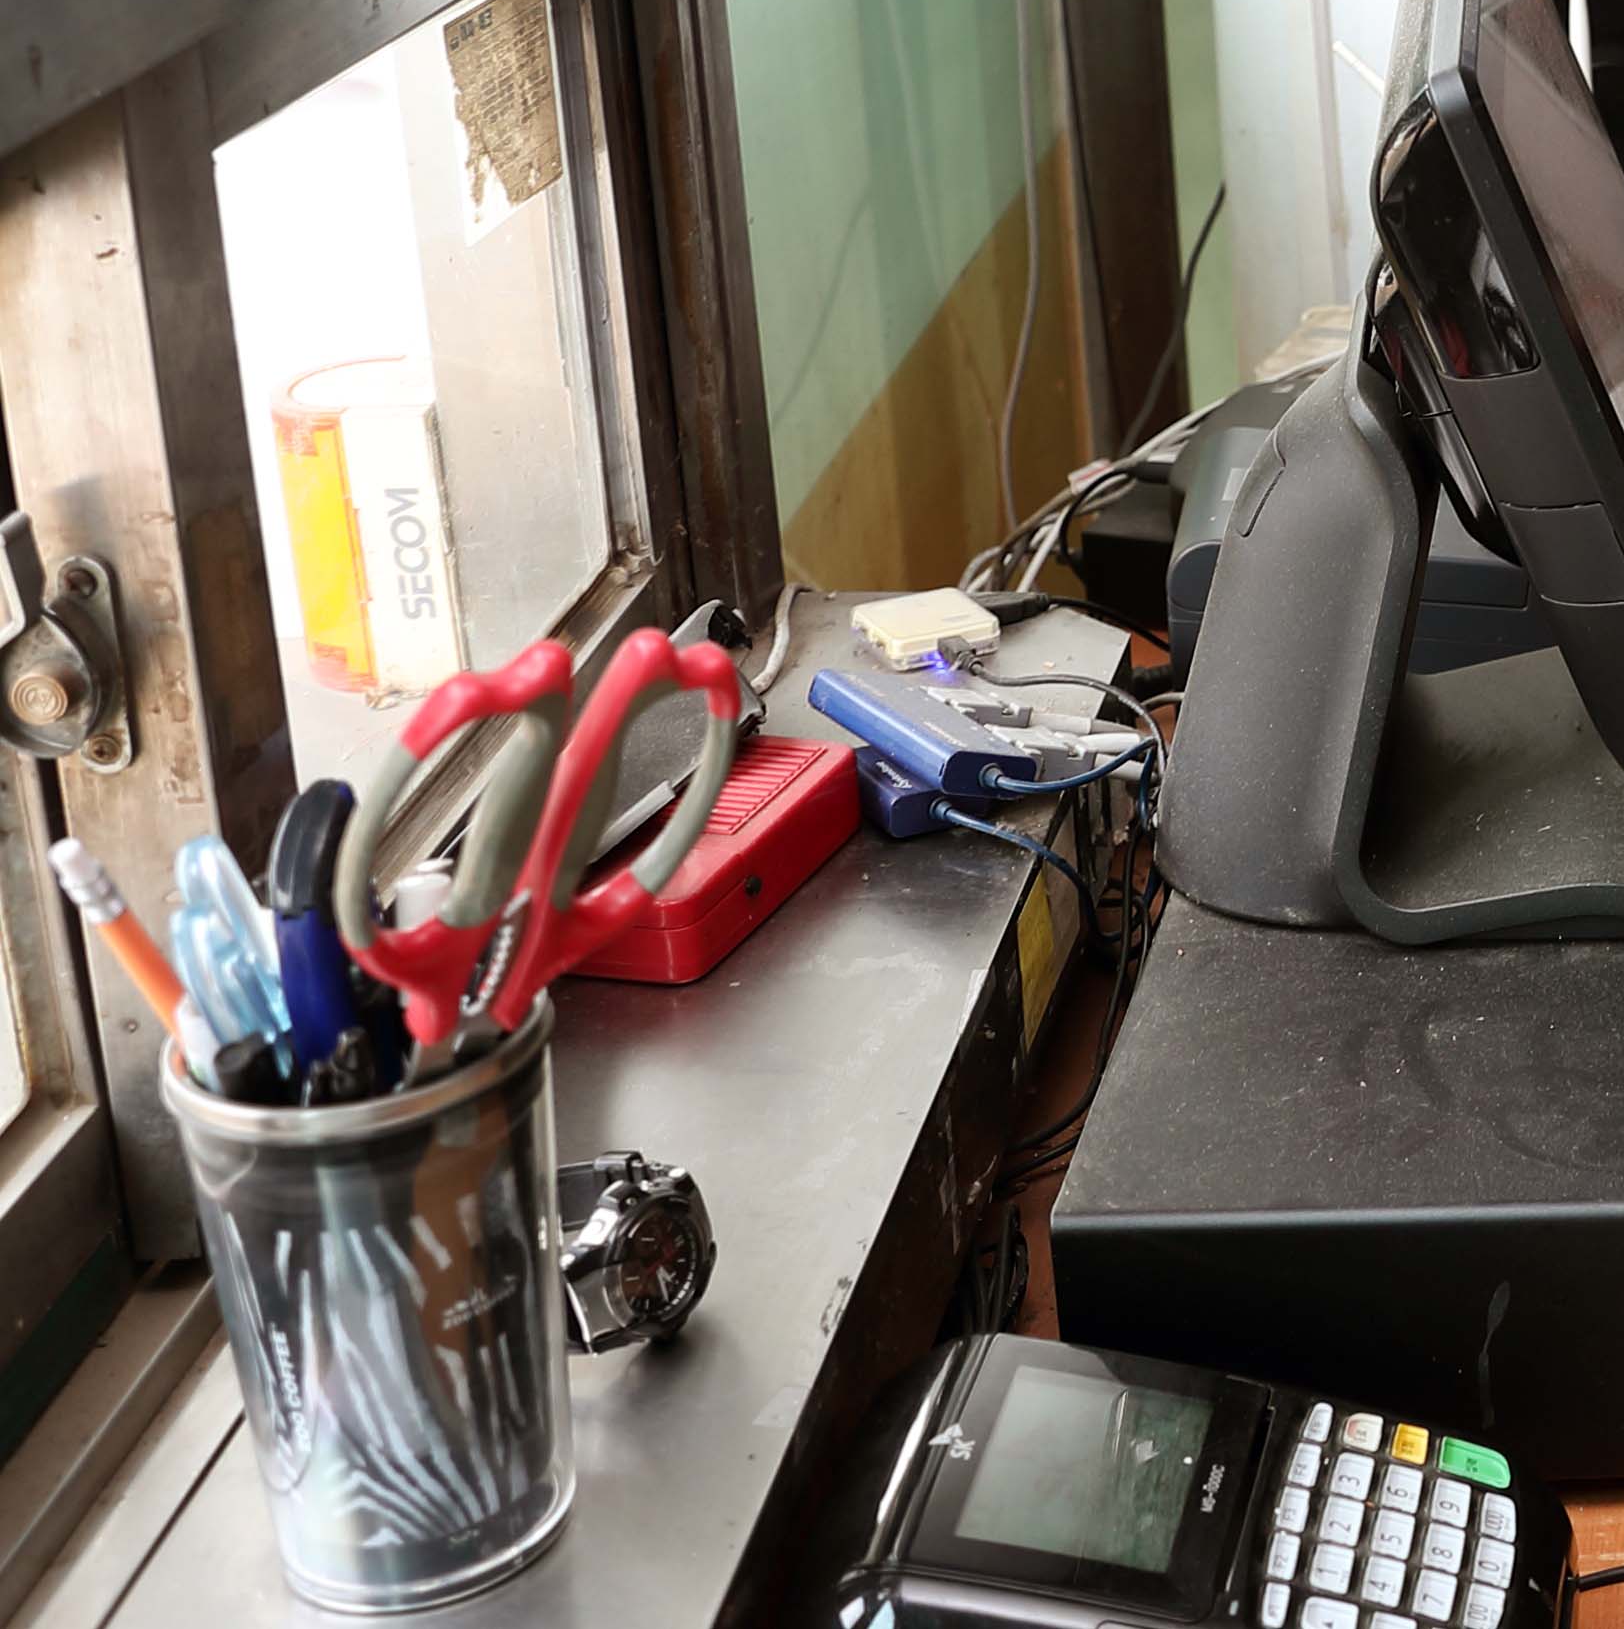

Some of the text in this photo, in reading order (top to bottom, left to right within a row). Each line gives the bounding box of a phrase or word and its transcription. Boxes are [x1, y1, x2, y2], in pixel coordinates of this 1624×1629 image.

[384, 487, 436, 620] SECOM
[273, 1331, 302, 1409] COFFEE
[950, 1440, 976, 1461] SK
[1339, 1474, 1360, 1486] 3
[1386, 1488, 1408, 1498] 6
[1440, 1501, 1460, 1512] 9
[1329, 1521, 1351, 1533] 2
[1381, 1534, 1400, 1544] 5
[1432, 1547, 1452, 1559] 8
[1317, 1567, 1339, 1575] 1
[1478, 1561, 1500, 1571] 0
[1370, 1579, 1389, 1591] 4
[1423, 1593, 1440, 1605] 7
